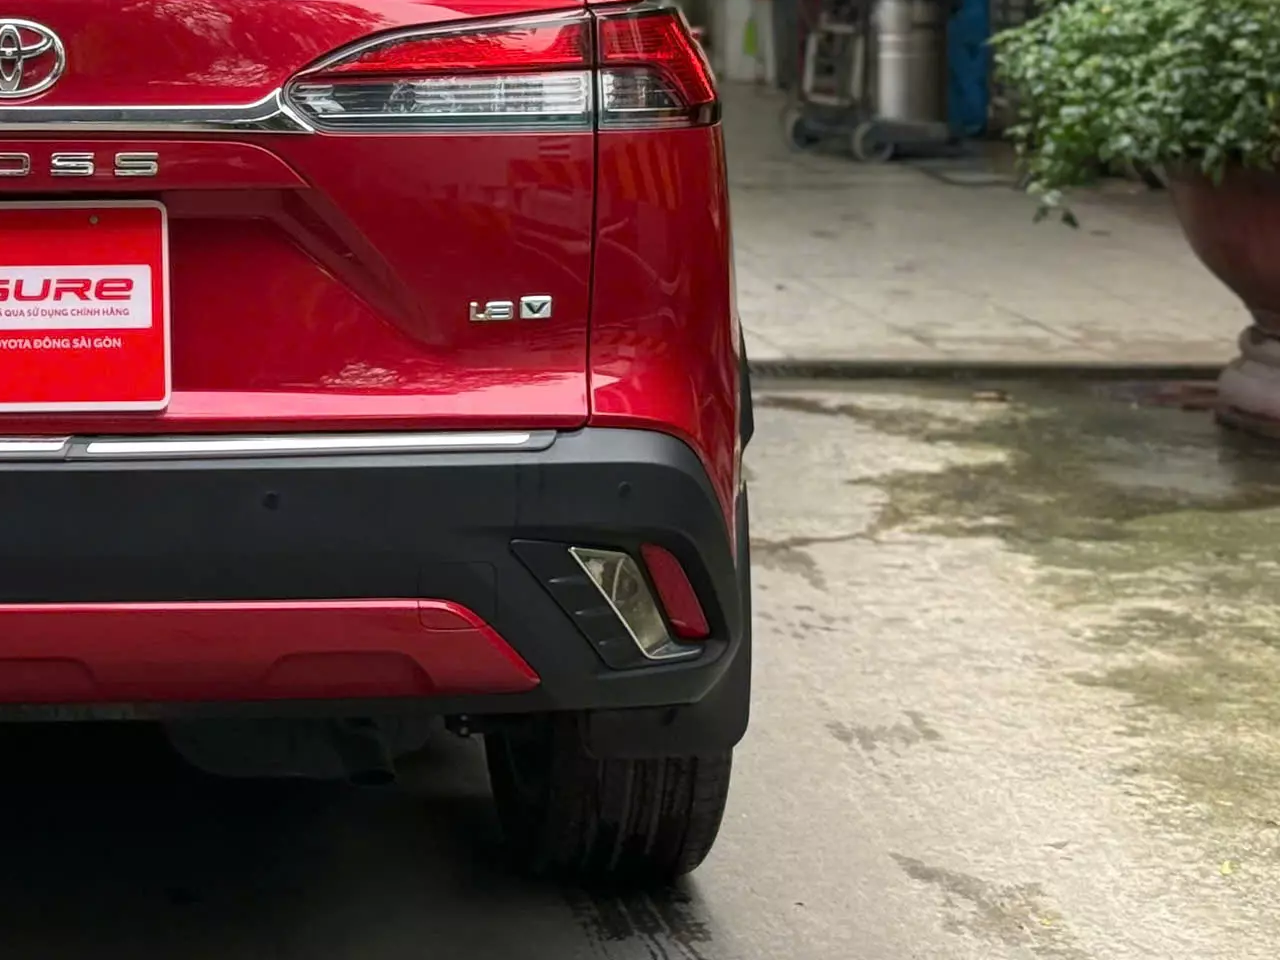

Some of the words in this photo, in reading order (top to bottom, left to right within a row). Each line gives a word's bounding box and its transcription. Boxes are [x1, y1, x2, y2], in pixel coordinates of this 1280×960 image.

[4, 308, 26, 319] QUA
[27, 306, 40, 317] SỬ
[41, 308, 69, 319] DỤNG
[70, 306, 101, 317] CHÍNH
[102, 307, 130, 316] HÃNG
[521, 296, 552, 318] V
[33, 336, 70, 349] ĐÔNG
[72, 336, 92, 349] SÀI
[93, 335, 122, 348] GÒN
